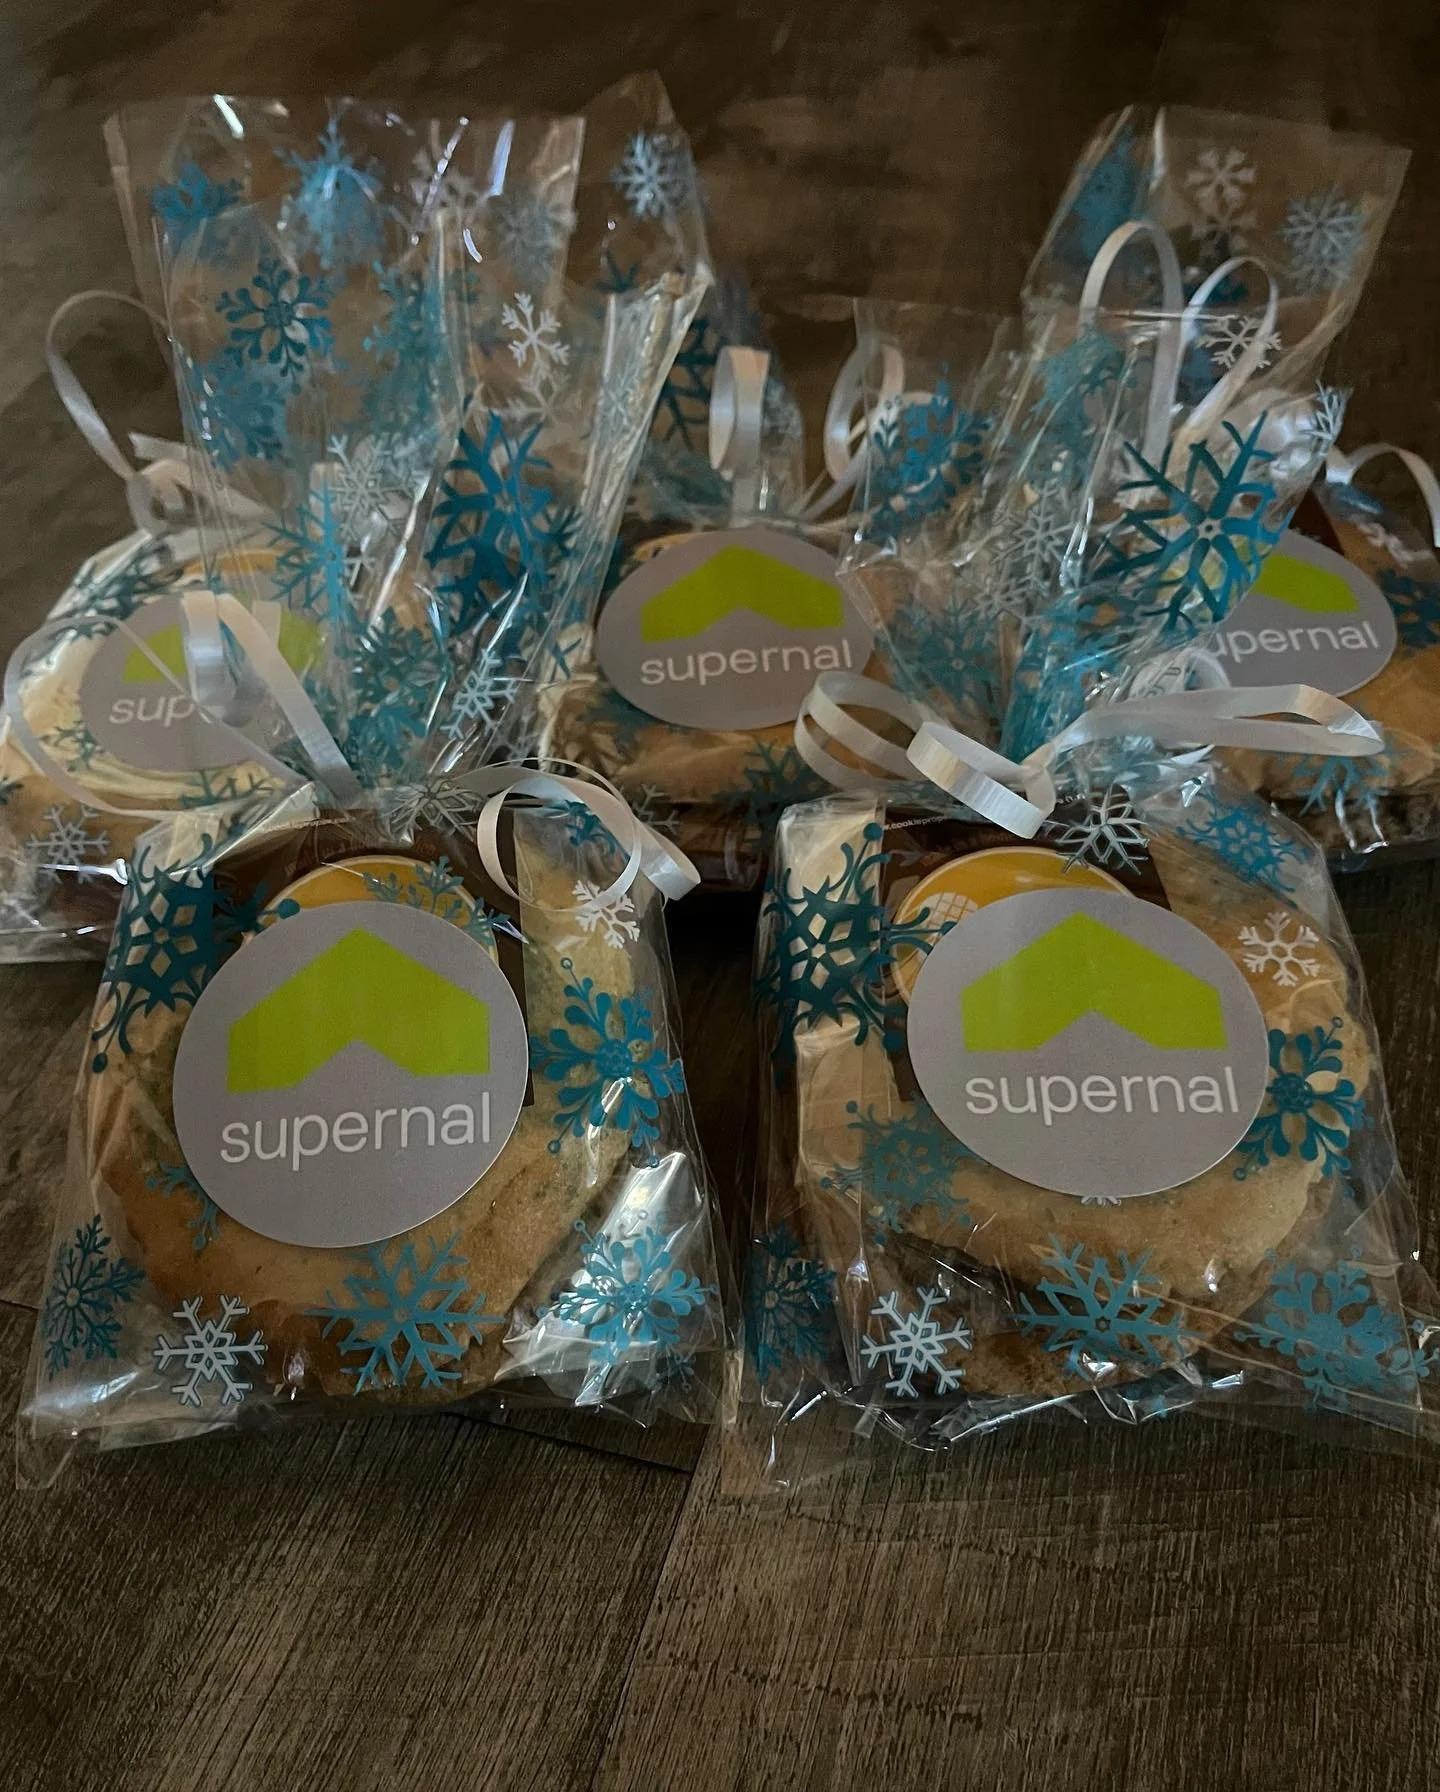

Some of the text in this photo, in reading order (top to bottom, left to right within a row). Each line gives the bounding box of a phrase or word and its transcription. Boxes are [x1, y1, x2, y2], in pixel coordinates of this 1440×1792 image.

[640, 638, 854, 686] supernal
[965, 1065, 1240, 1127] supernal
[219, 1091, 491, 1172] supernal
